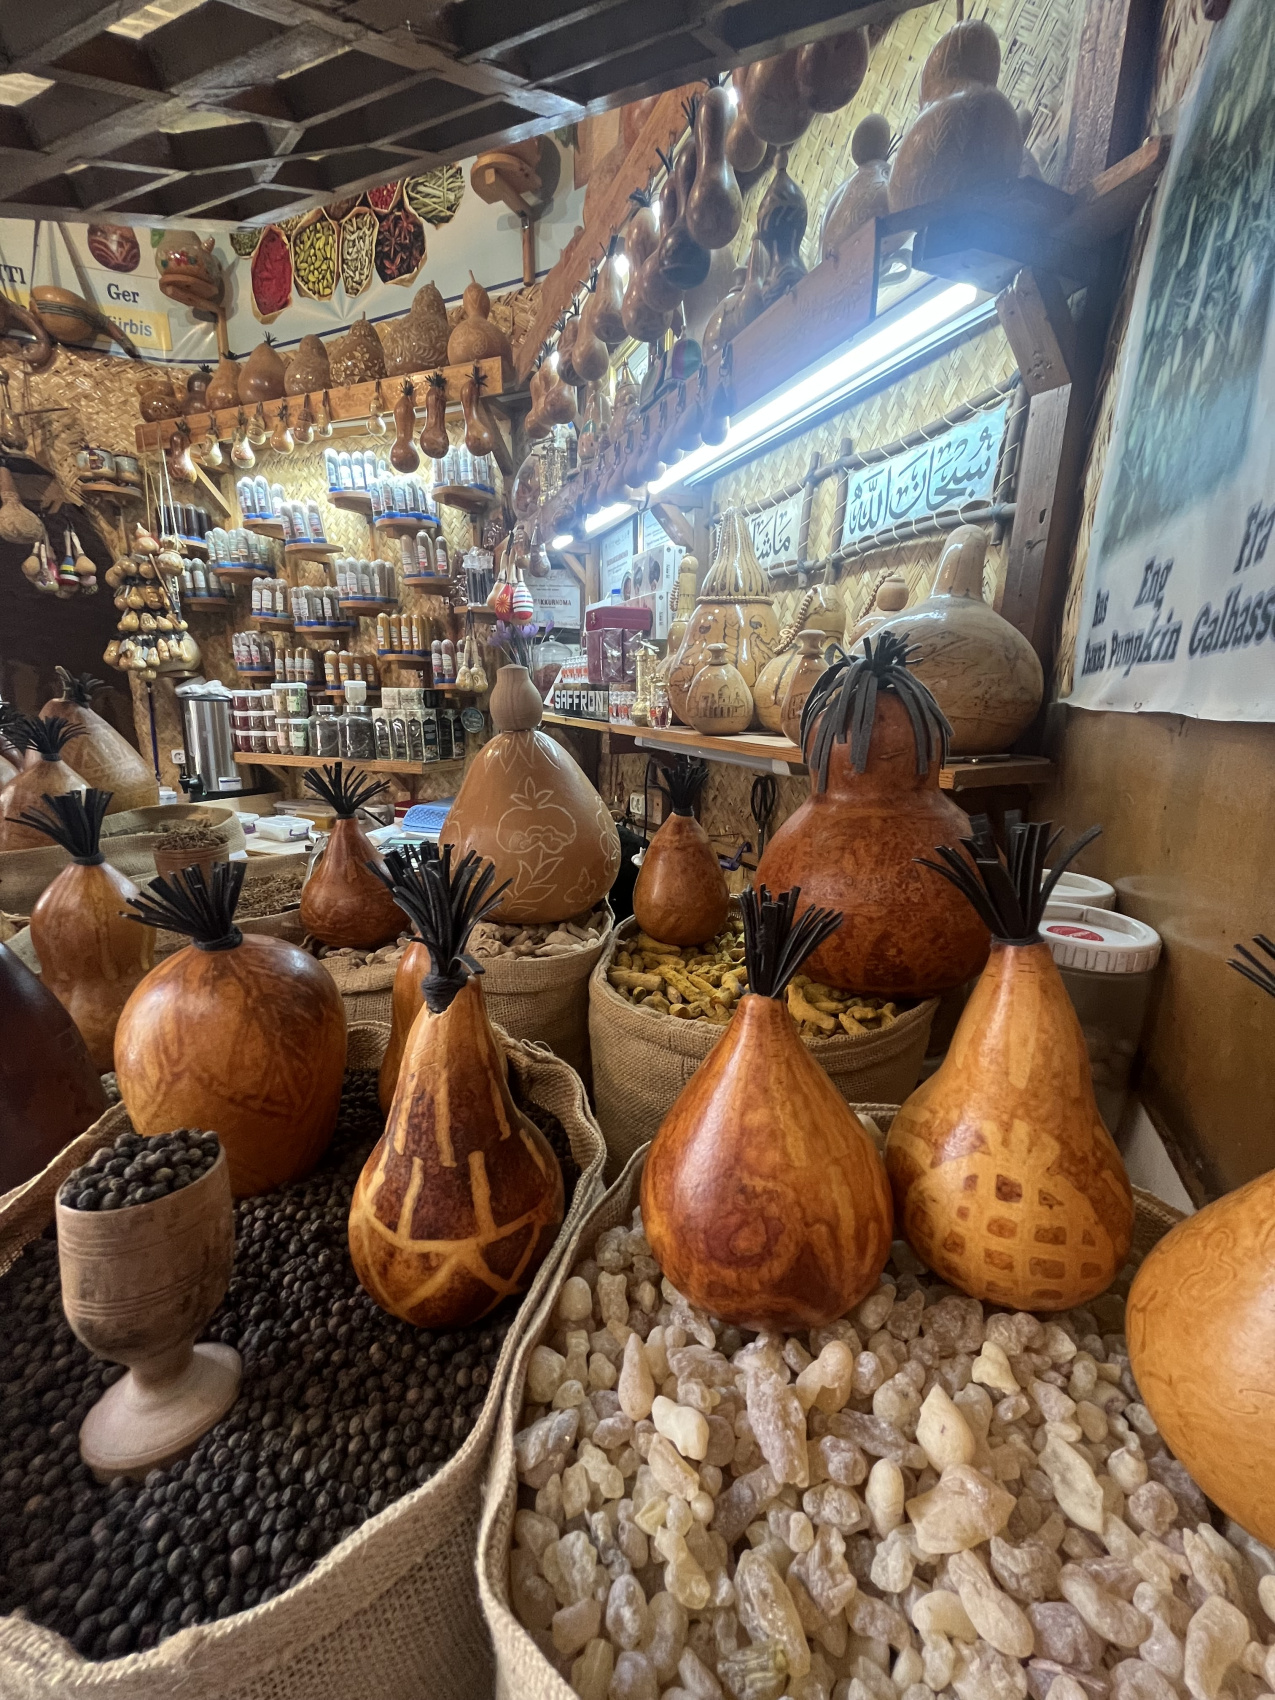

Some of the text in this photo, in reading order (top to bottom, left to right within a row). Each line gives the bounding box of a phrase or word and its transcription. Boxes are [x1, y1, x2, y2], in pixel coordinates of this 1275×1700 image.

[107, 283, 139, 303] Ger
[109, 316, 152, 337] ürbis
[1233, 500, 1275, 574] Fra
[1133, 557, 1174, 611] Eng
[1108, 608, 1182, 677] Pumpkin
[555, 690, 604, 712] SAFFRON
